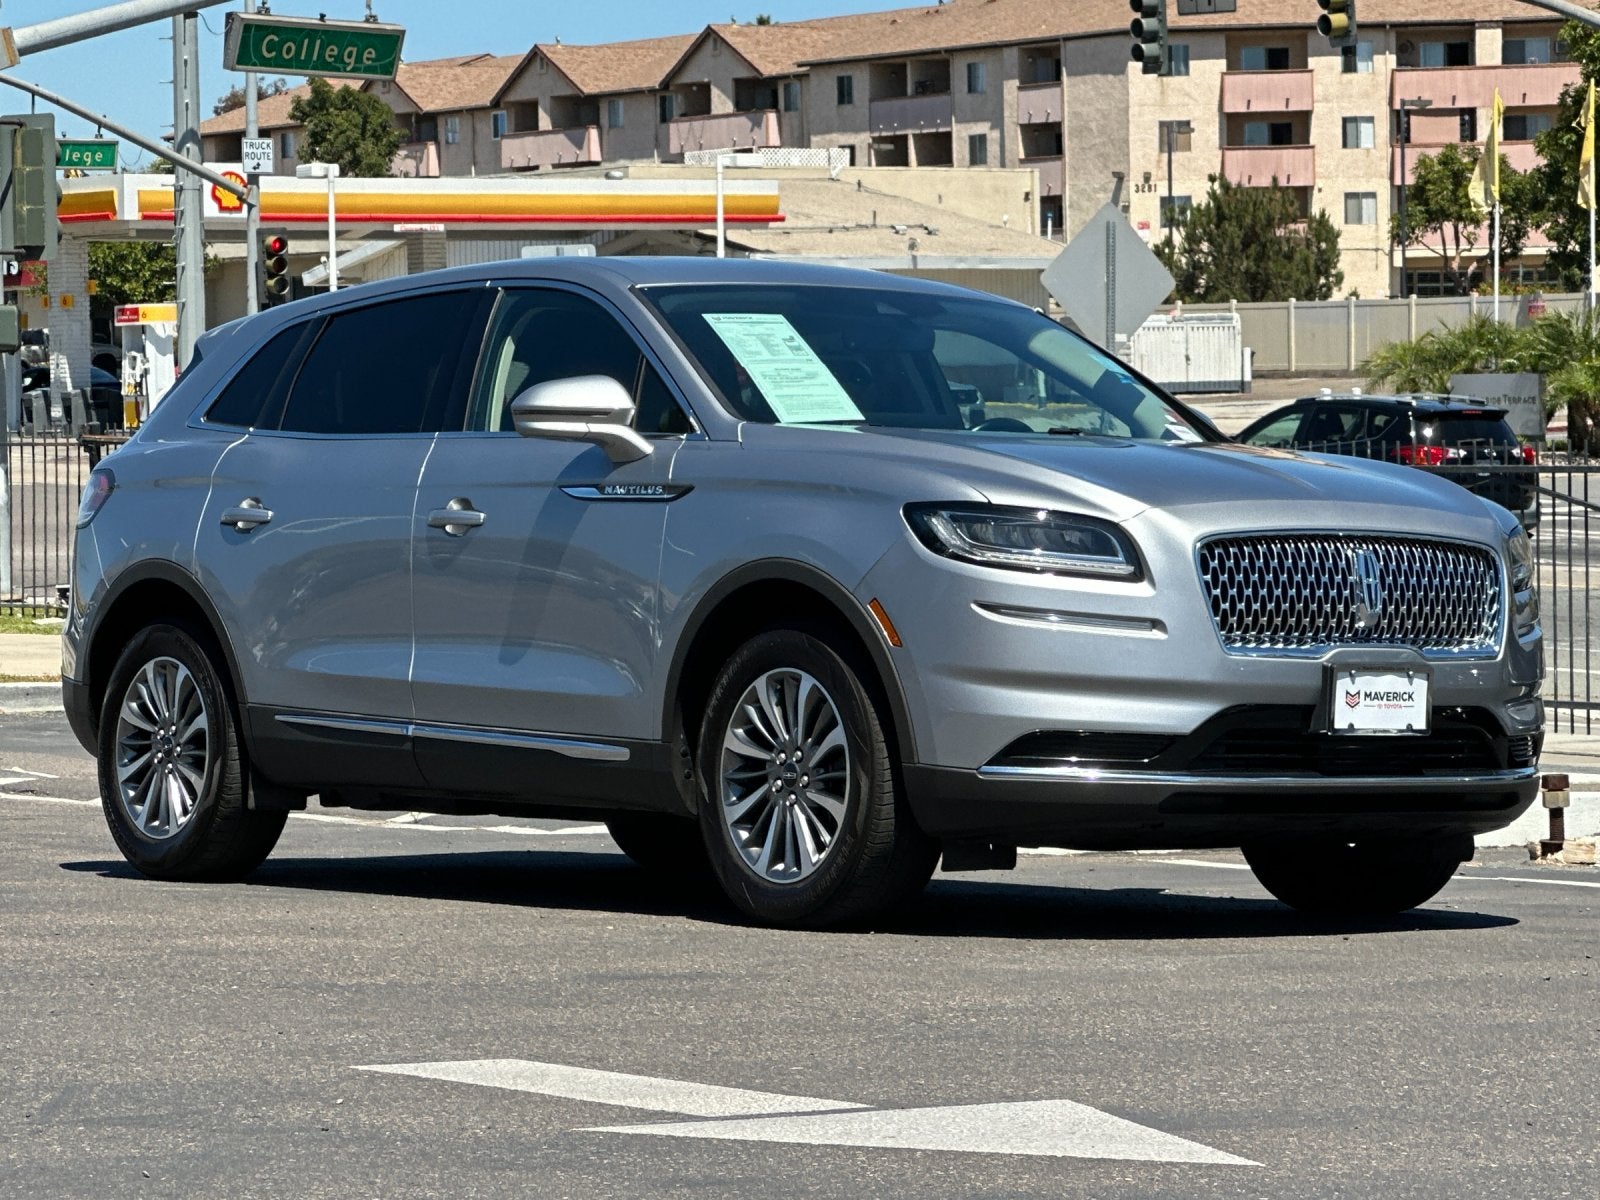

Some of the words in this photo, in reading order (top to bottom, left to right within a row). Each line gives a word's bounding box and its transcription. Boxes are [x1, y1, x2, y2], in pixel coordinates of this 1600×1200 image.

[261, 34, 376, 71] College
[244, 141, 271, 150] TRUCK
[65, 149, 103, 166] lege
[244, 152, 271, 161] ROUTE
[604, 485, 663, 495] NAUTILUS
[1364, 691, 1414, 701] MAVERICK
